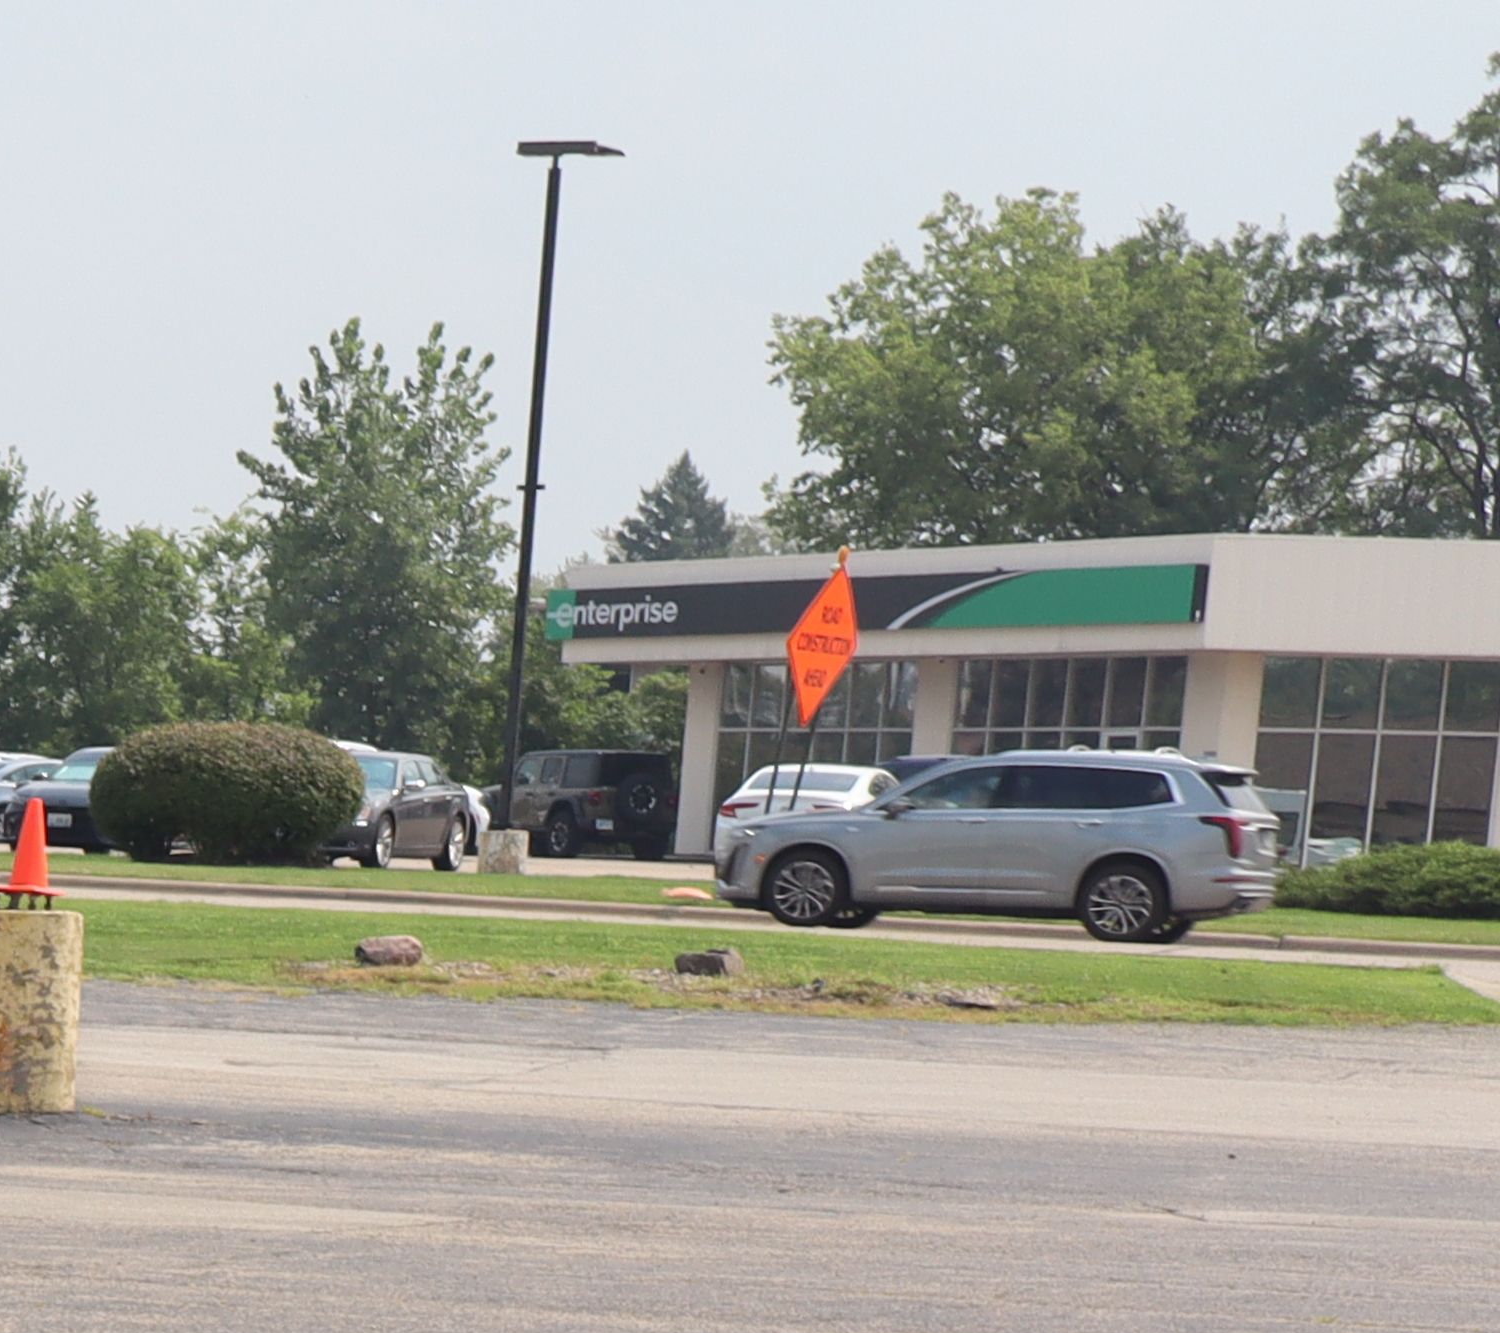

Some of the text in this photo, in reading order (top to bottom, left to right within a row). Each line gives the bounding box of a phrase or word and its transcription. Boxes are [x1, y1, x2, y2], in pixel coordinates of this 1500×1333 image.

[549, 595, 678, 631] enterprise
[822, 606, 843, 624] ROAD
[797, 632, 851, 656] CONSTRUCTION
[804, 669, 827, 687] AHEAD
